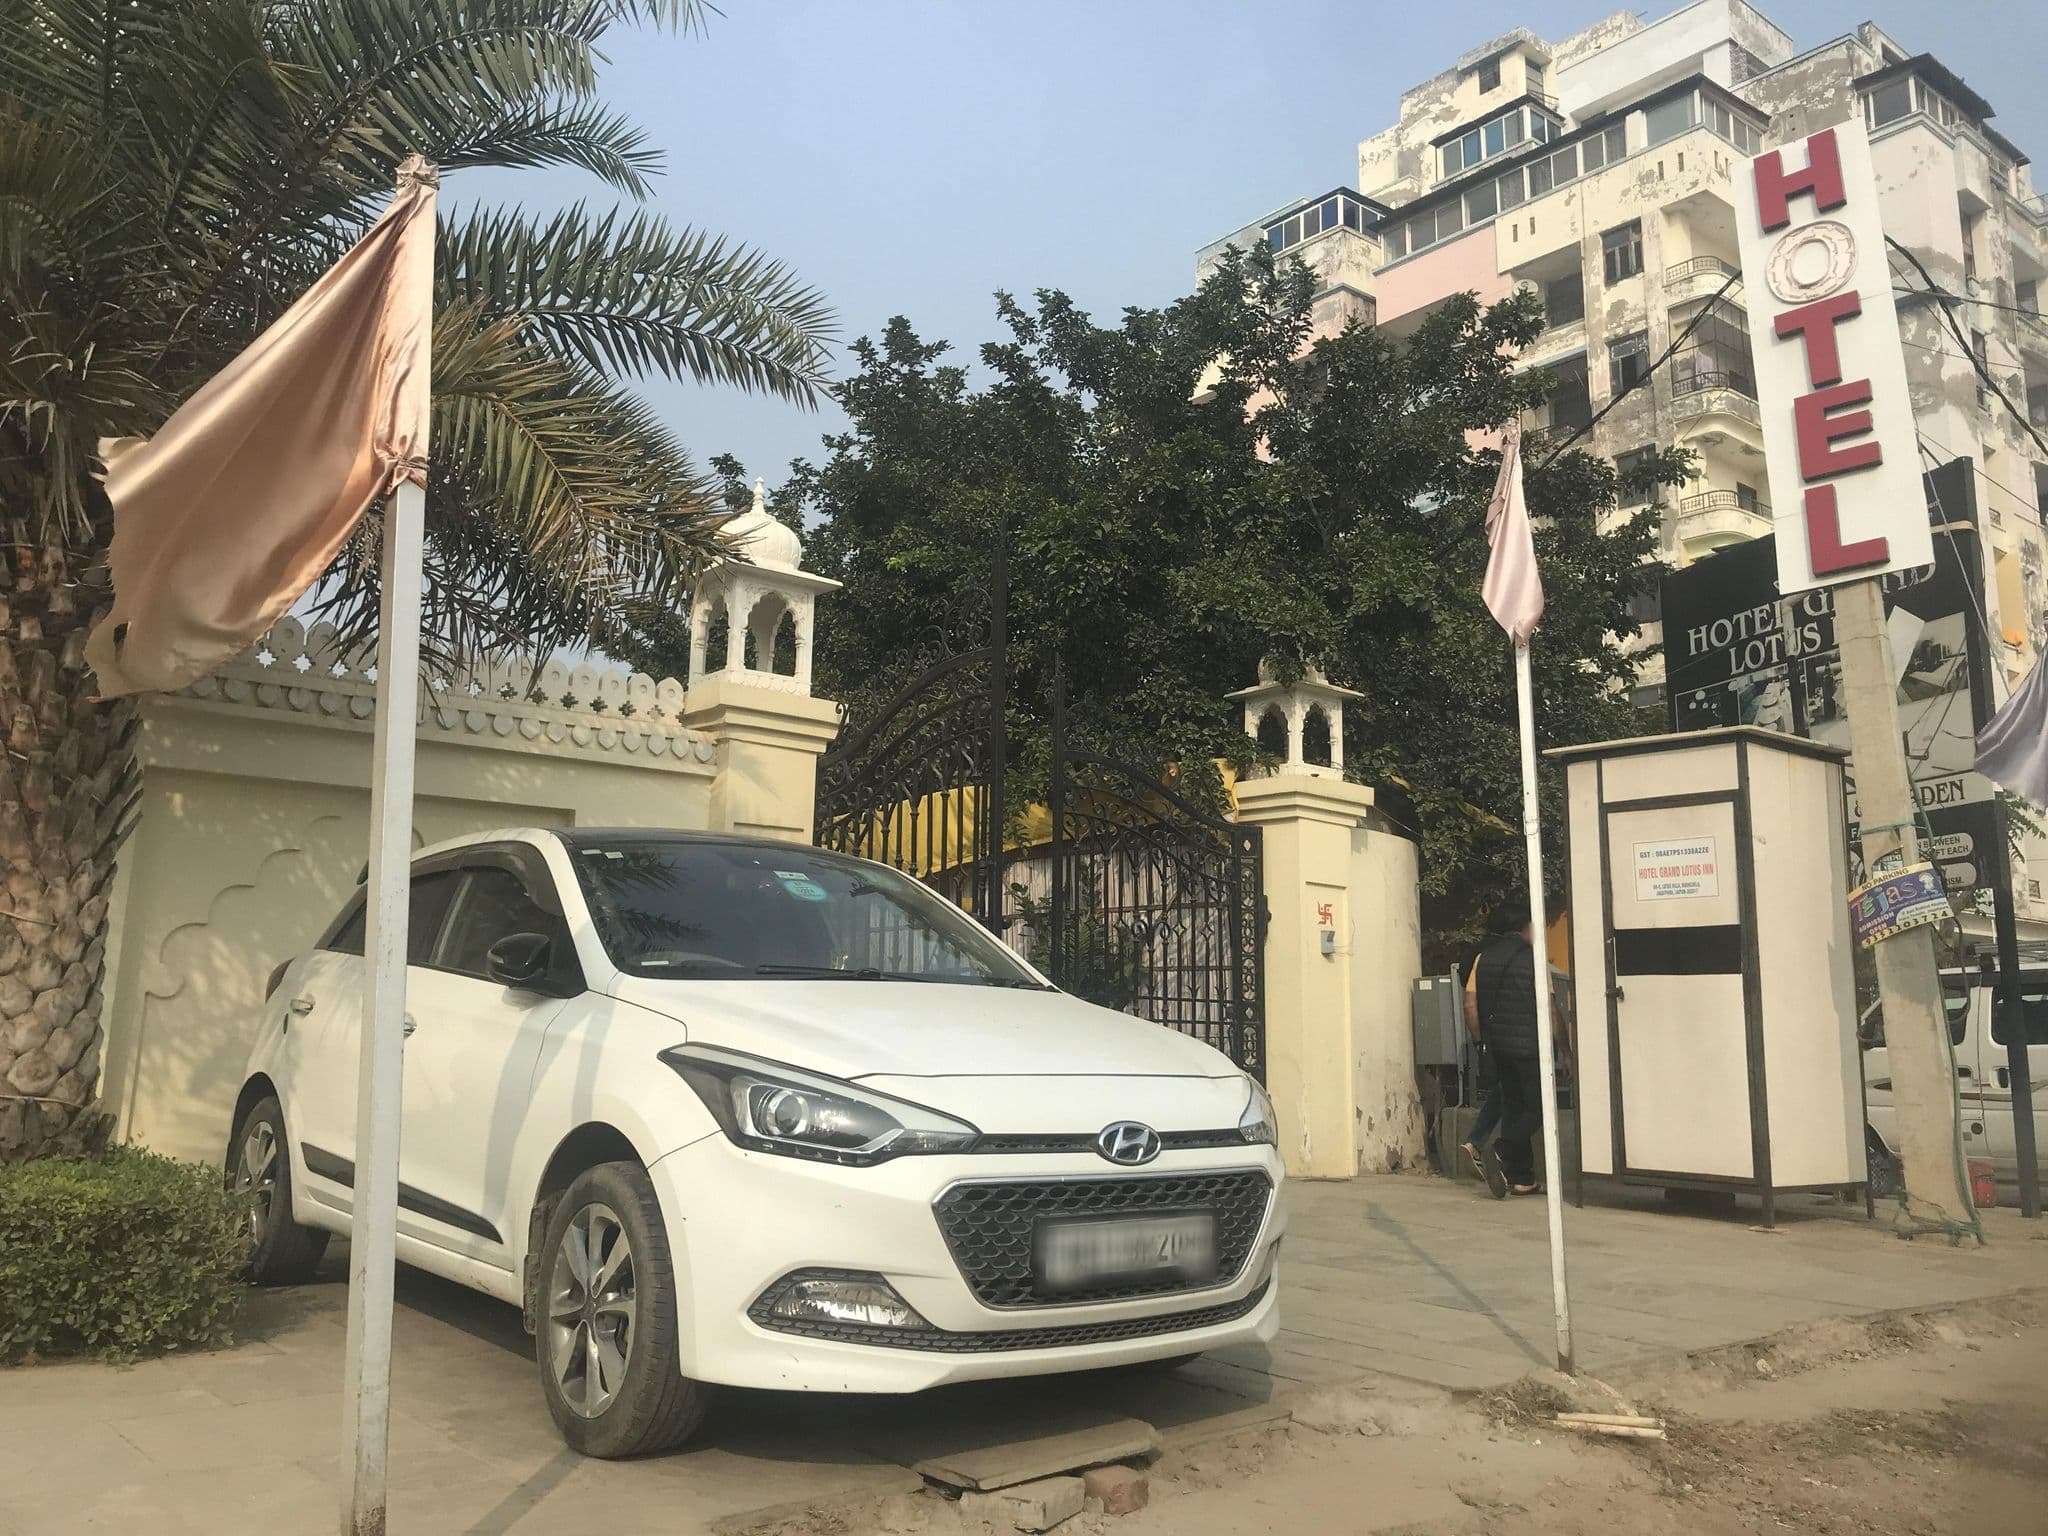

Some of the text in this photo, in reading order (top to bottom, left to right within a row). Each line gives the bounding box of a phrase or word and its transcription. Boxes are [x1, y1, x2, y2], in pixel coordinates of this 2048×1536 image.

[1753, 128, 1890, 578] HOTEL
[1639, 851, 1651, 859] GST
[1946, 845, 1969, 855] EACH
[1639, 863, 1714, 880] HOTEL GRAND LOTUS INN
[1861, 867, 1910, 891] NO PARKING
[1859, 911, 1895, 934] ADMISSION
[1868, 922, 1888, 936] OPEN
